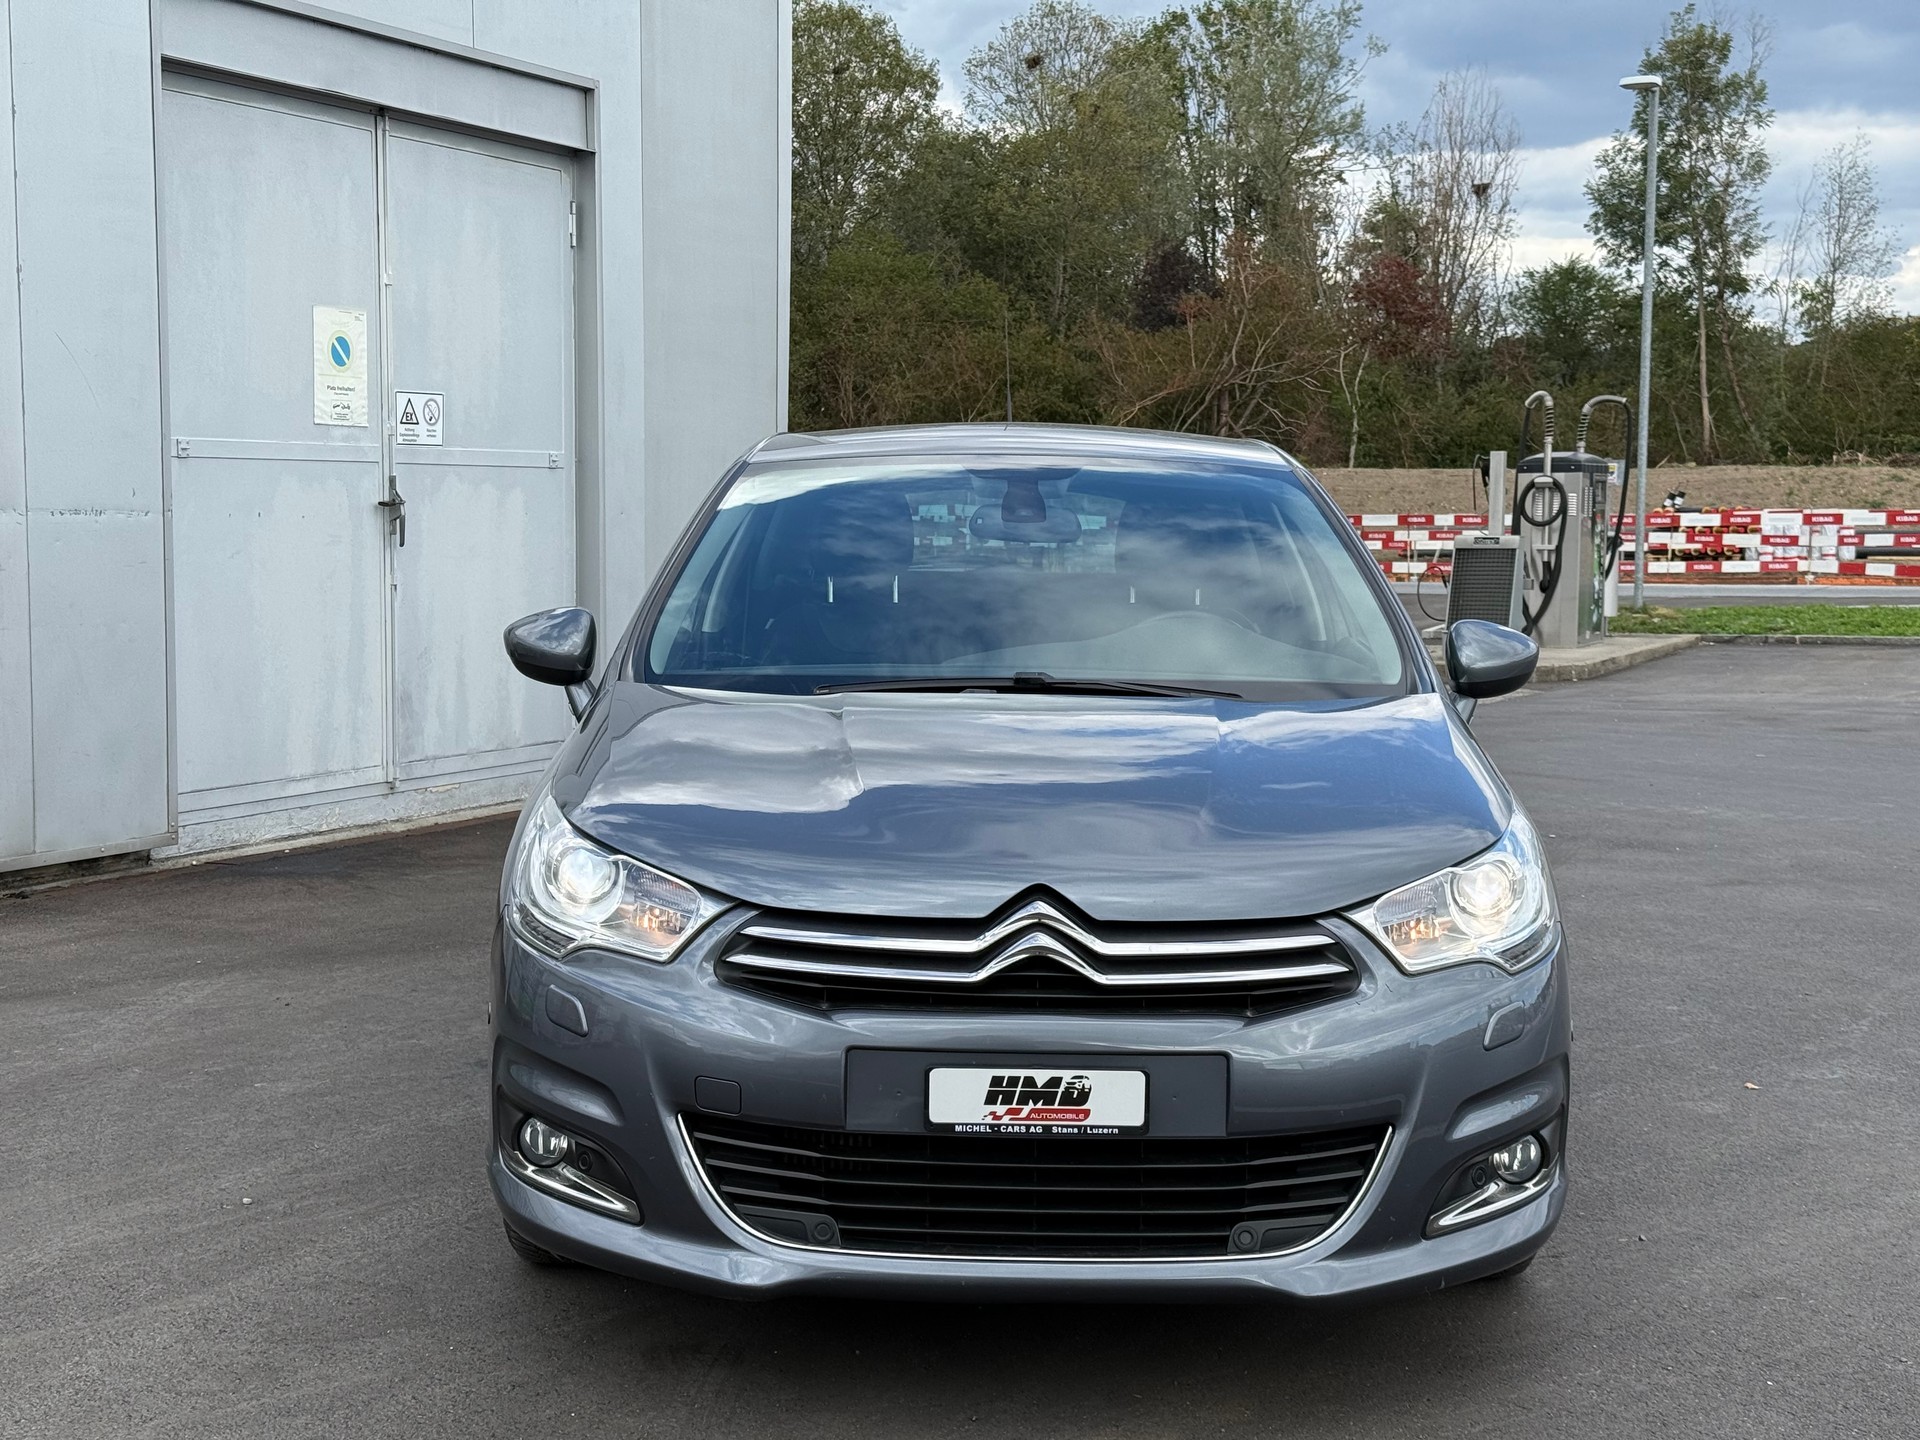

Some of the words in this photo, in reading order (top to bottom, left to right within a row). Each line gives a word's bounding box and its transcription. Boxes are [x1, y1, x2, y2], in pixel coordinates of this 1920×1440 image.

[405, 412, 414, 421] EX
[1030, 1112, 1085, 1120] AUTOMOBILE
[954, 1124, 992, 1133] MICHEL
[1000, 1125, 1026, 1133] CARS
[1052, 1126, 1079, 1134] Stans
[1087, 1126, 1119, 1134] Luzern
